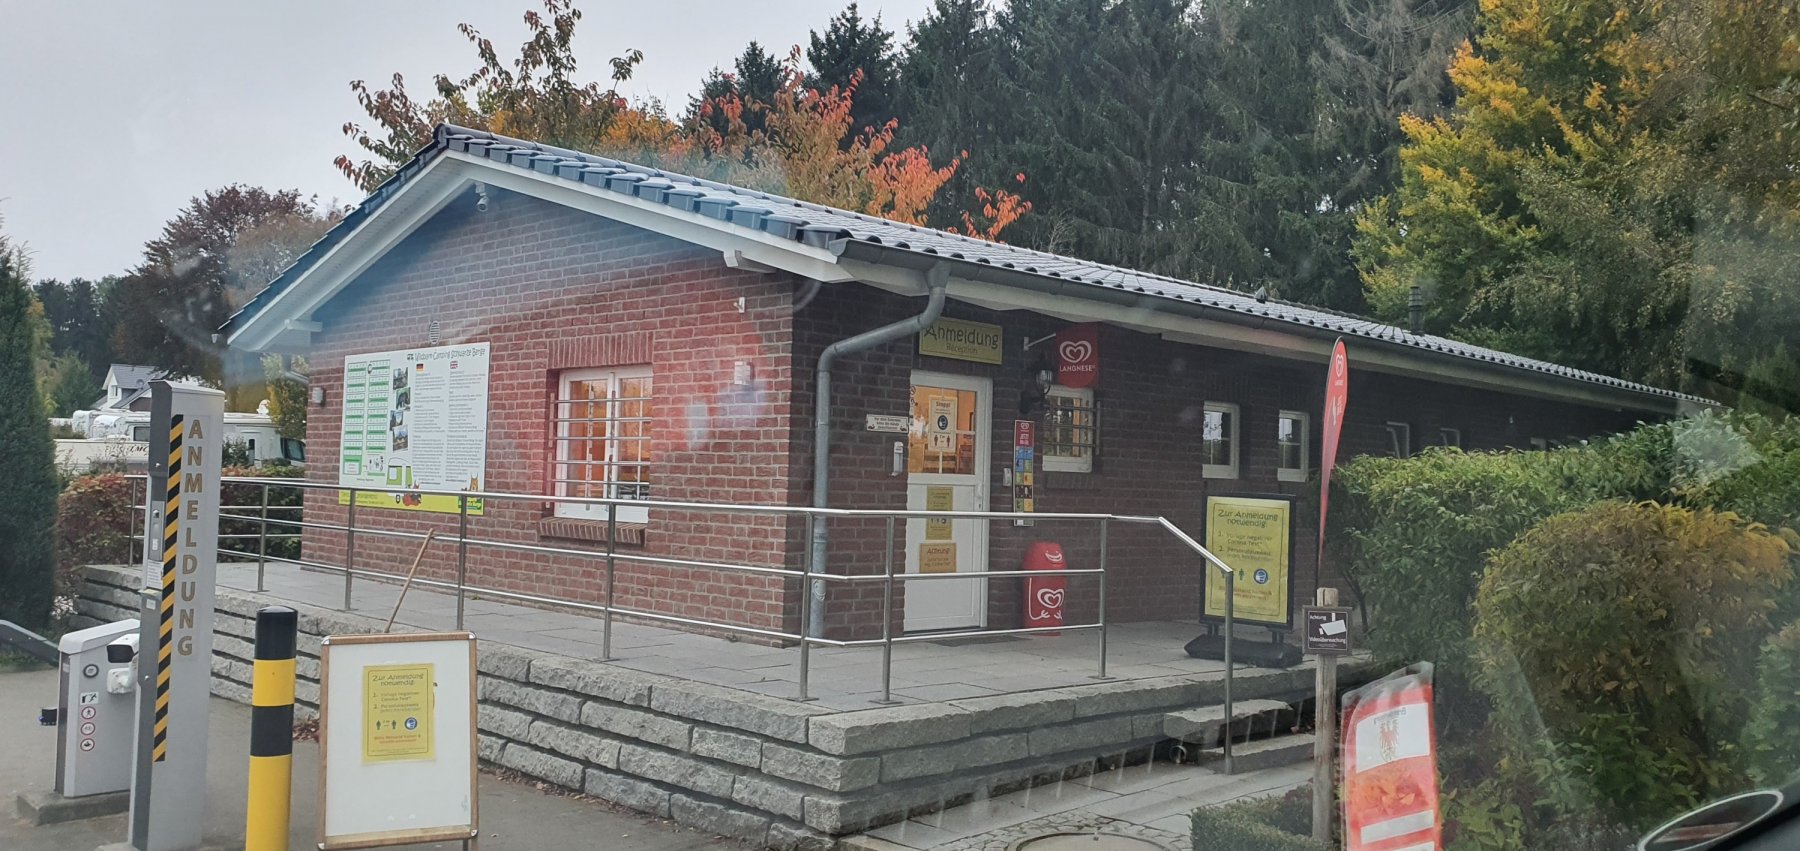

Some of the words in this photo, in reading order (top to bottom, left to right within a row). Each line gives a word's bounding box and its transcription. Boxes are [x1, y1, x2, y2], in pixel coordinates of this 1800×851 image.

[924, 324, 998, 349] Anmeldung
[1218, 509, 1233, 518] Zur
[1234, 511, 1278, 521] Anmeldung
[177, 418, 203, 657] ANMELDUNG
